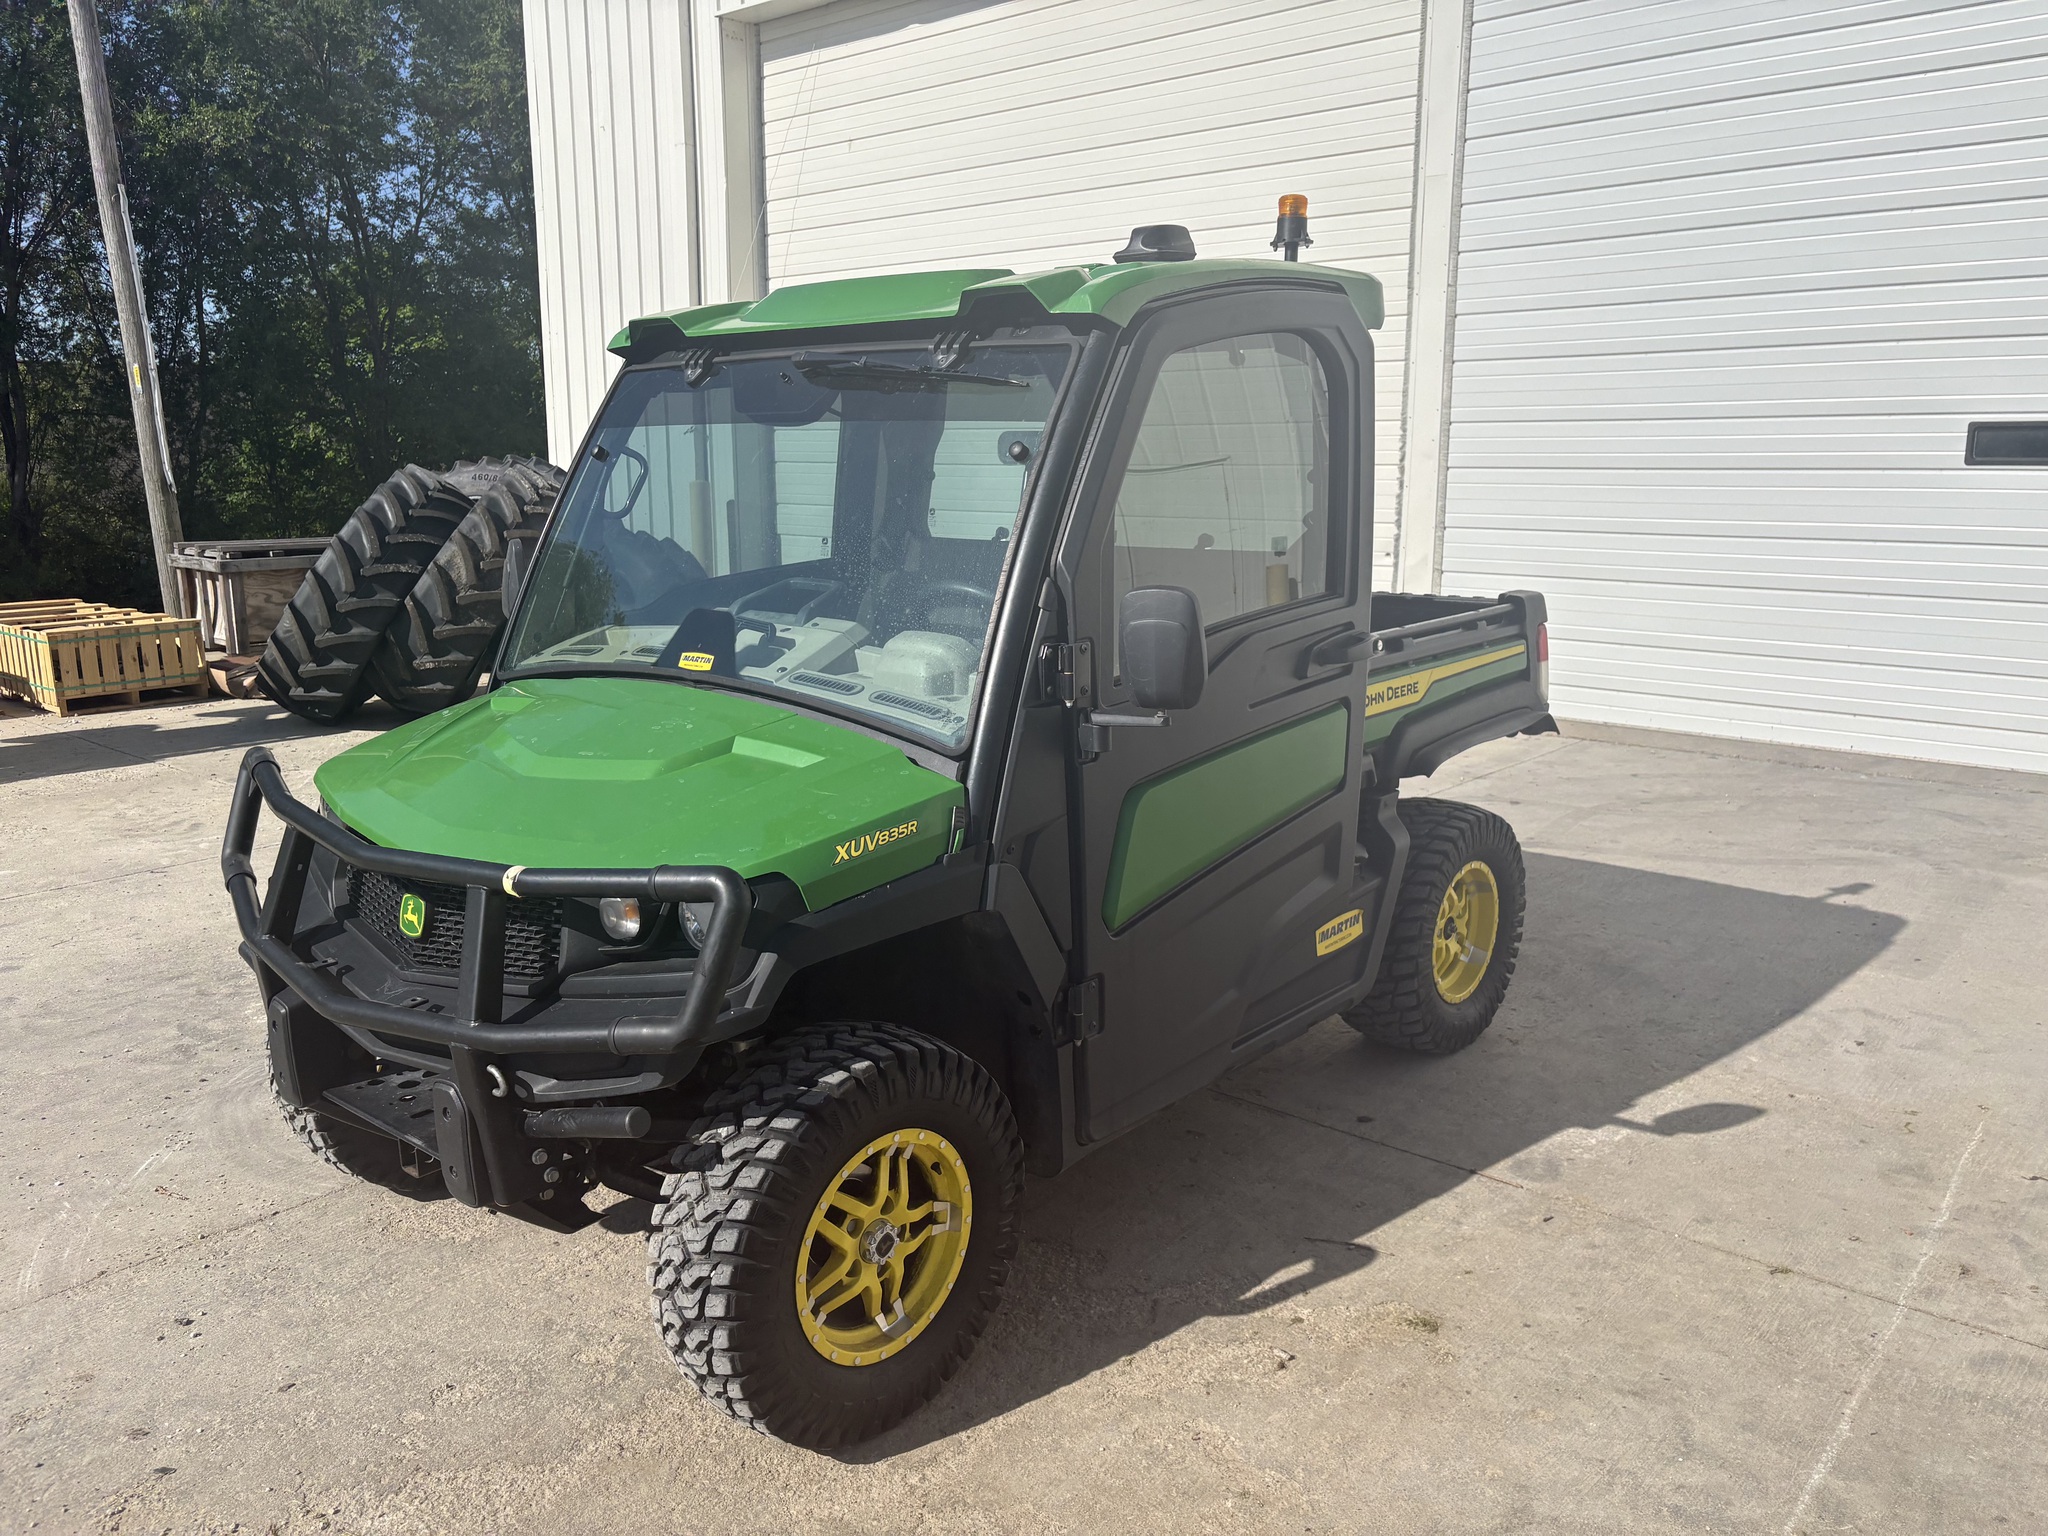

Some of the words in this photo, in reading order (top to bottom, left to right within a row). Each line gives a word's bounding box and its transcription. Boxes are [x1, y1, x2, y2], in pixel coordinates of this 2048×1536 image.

[471, 473, 501, 482] 460/8
[683, 655, 712, 664] MARTIN
[1365, 690, 1385, 708] OHN
[1386, 681, 1419, 702] DEERE
[832, 820, 918, 866] XUV835R
[1319, 913, 1360, 943] MARTIN
